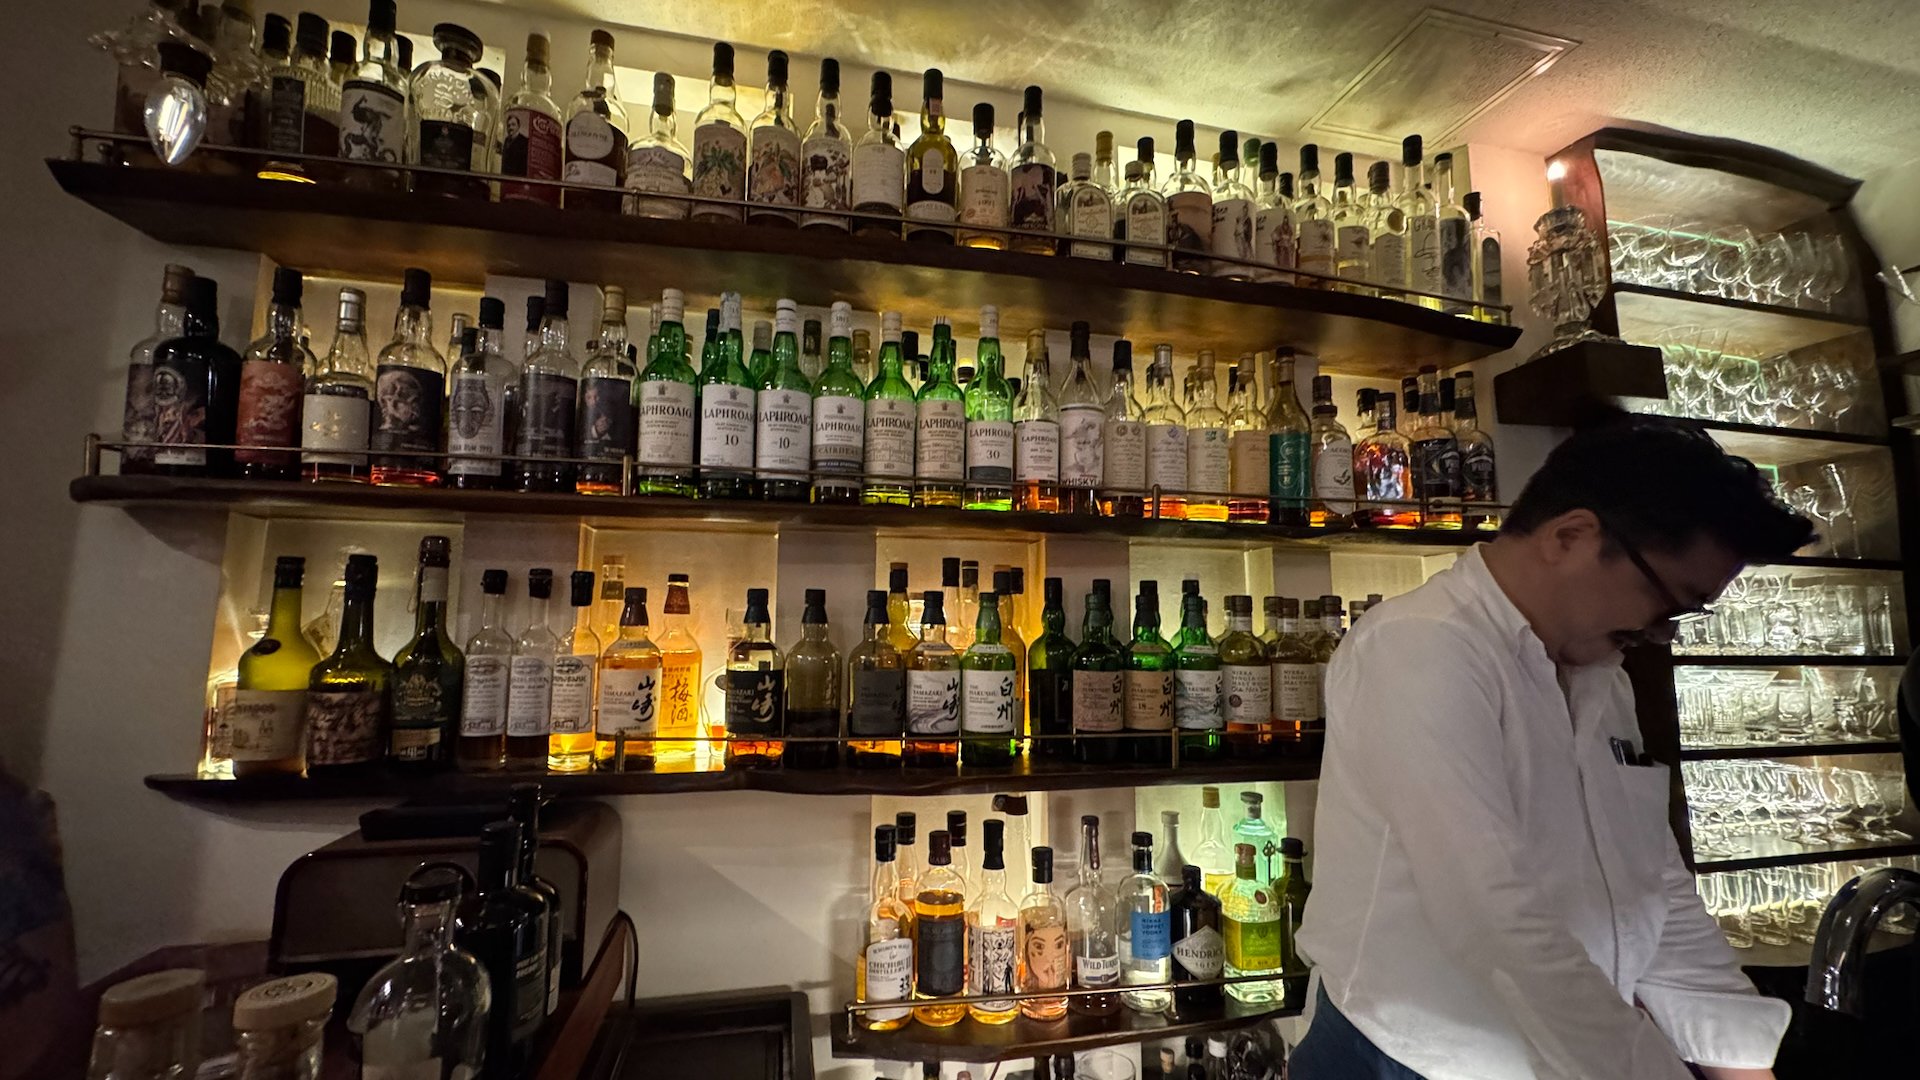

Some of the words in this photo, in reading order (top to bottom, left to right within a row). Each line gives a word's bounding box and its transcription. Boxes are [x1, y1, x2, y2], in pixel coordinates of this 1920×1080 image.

[704, 408, 752, 423] LAPHROAI
[725, 433, 739, 447] 10
[779, 437, 791, 449] 10
[986, 449, 1000, 460] 30
[631, 675, 656, 722] 山崎
[668, 677, 693, 726] 梅酒
[751, 673, 777, 723] 山崎
[997, 676, 1014, 723] 白州
[1083, 959, 1101, 970] WILD
